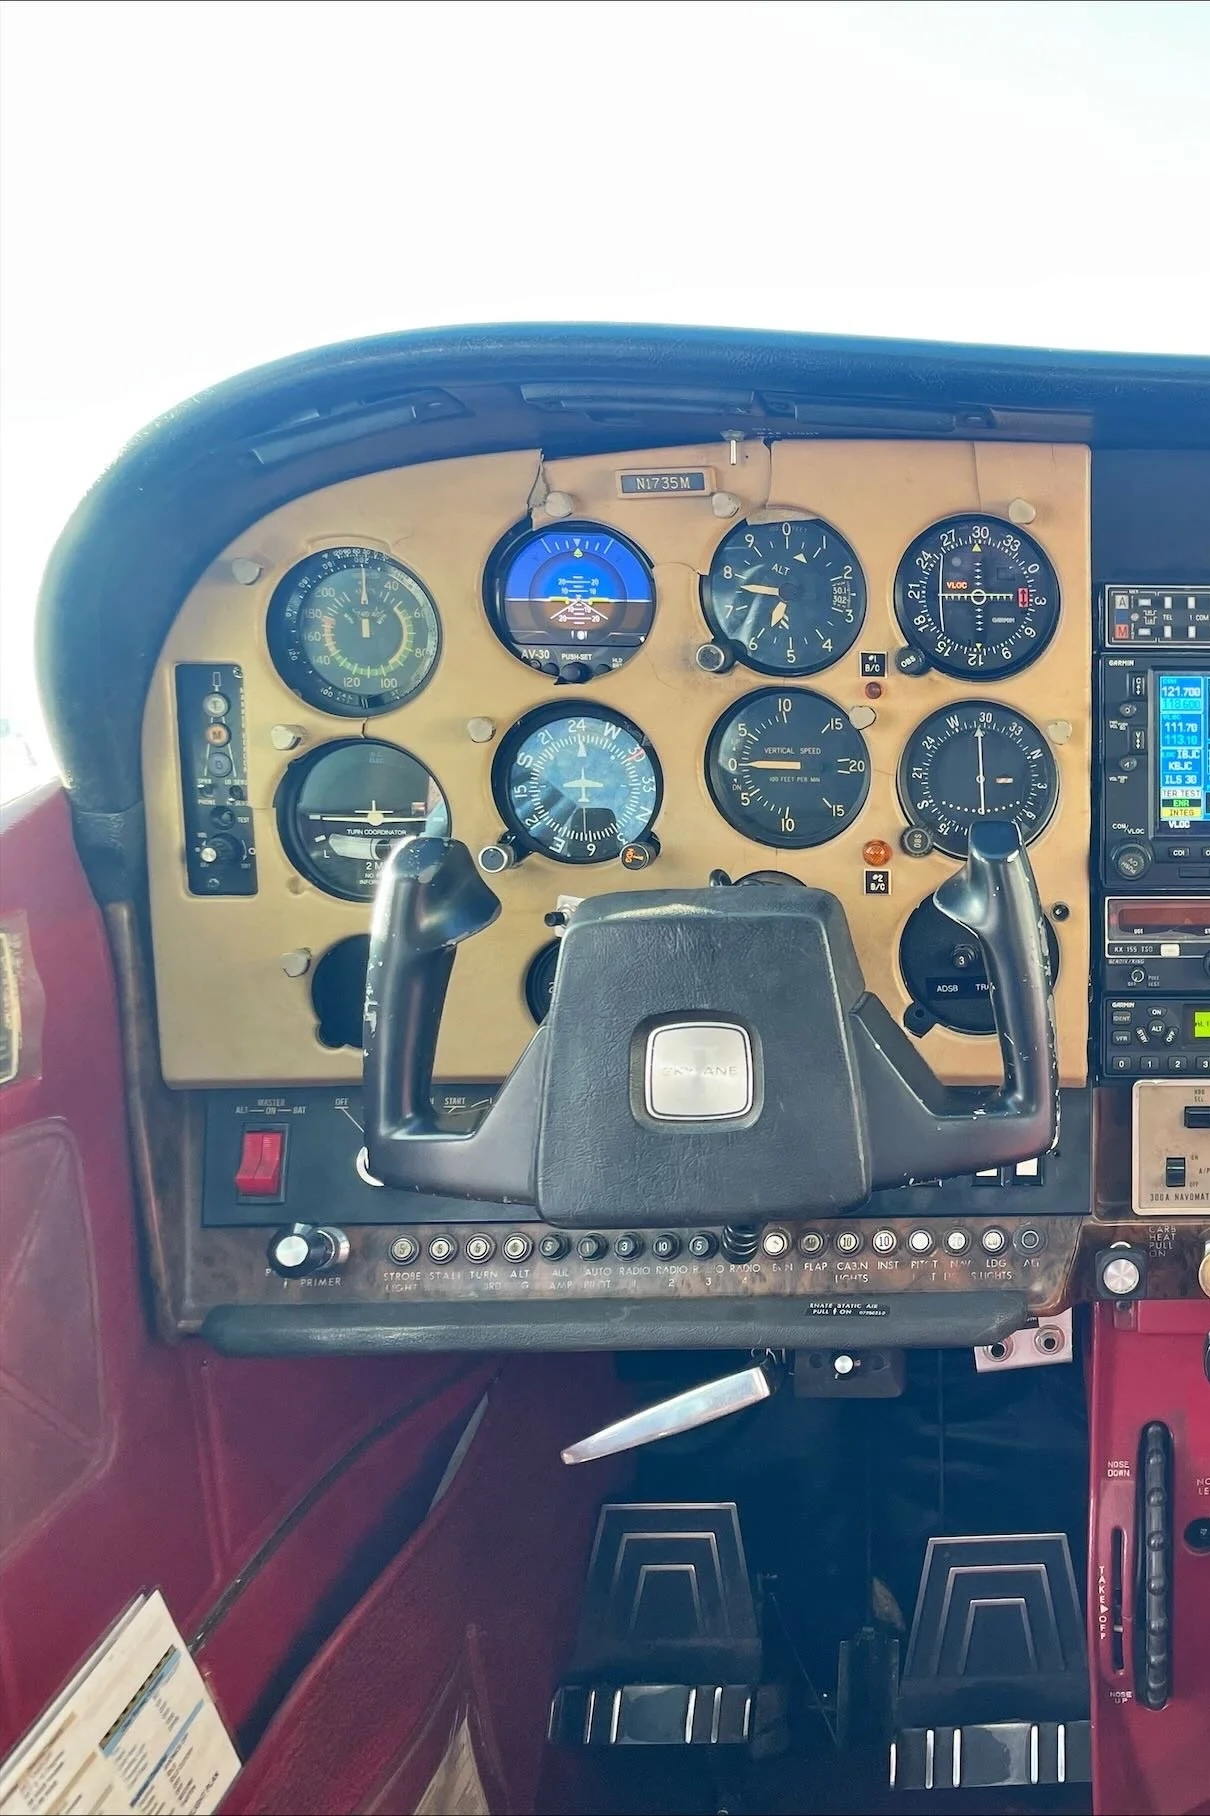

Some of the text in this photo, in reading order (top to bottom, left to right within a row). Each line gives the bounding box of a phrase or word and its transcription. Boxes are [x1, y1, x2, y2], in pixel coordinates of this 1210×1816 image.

[636, 477, 691, 490] N1735M
[939, 529, 957, 547] 27
[972, 526, 990, 539] 30
[1002, 534, 1021, 552] 33
[915, 550, 933, 569] 24
[771, 563, 790, 576] ALT
[908, 583, 920, 599] 21
[520, 650, 550, 659] AV-30
[561, 653, 593, 661] PUSH-SET
[967, 653, 984, 666] 12
[900, 655, 916, 668] OBS
[865, 664, 880, 672] B/C
[343, 677, 360, 688] 120
[380, 678, 397, 689] 100
[778, 699, 792, 712] 10
[979, 712, 993, 723] 30
[567, 718, 586, 733] 24
[830, 718, 843, 731] 15
[1008, 722, 1023, 736] 33
[537, 729, 554, 745] 21
[922, 735, 935, 750] 24
[800, 747, 821, 755] SPEED
[1176, 749, 1200, 758] IBJC
[849, 760, 865, 773] 20
[1168, 761, 1193, 770] KBJC
[912, 767, 923, 779] 21
[1164, 775, 1182, 784] ILS
[513, 785, 527, 798] 15
[525, 814, 544, 830] 12
[781, 818, 795, 832] 10
[914, 833, 922, 848] OBS
[936, 985, 959, 993] ADSB
[257, 1099, 285, 1107] MASTER
[444, 1097, 466, 1105] START
[236, 1106, 248, 1114] ALT
[1198, 1167, 1210, 1175] A/P
[1150, 1193, 1170, 1201] 300A
[879, 1236, 890, 1247] 10
[1149, 1233, 1176, 1241] HEAT
[659, 1241, 668, 1250] 10
[729, 1264, 761, 1273] RADIO
[804, 1262, 828, 1271] FLAP
[877, 1261, 899, 1270] INST
[986, 1259, 1007, 1268] LDG
[510, 1269, 530, 1278] ALT
[619, 1266, 650, 1275] RADIO
[656, 1265, 688, 1274] RADIO
[383, 1272, 421, 1281] STROBE
[300, 1277, 341, 1288] PRIMER
[1108, 1460, 1129, 1469] NOSE
[1107, 1469, 1130, 1477] DOWN
